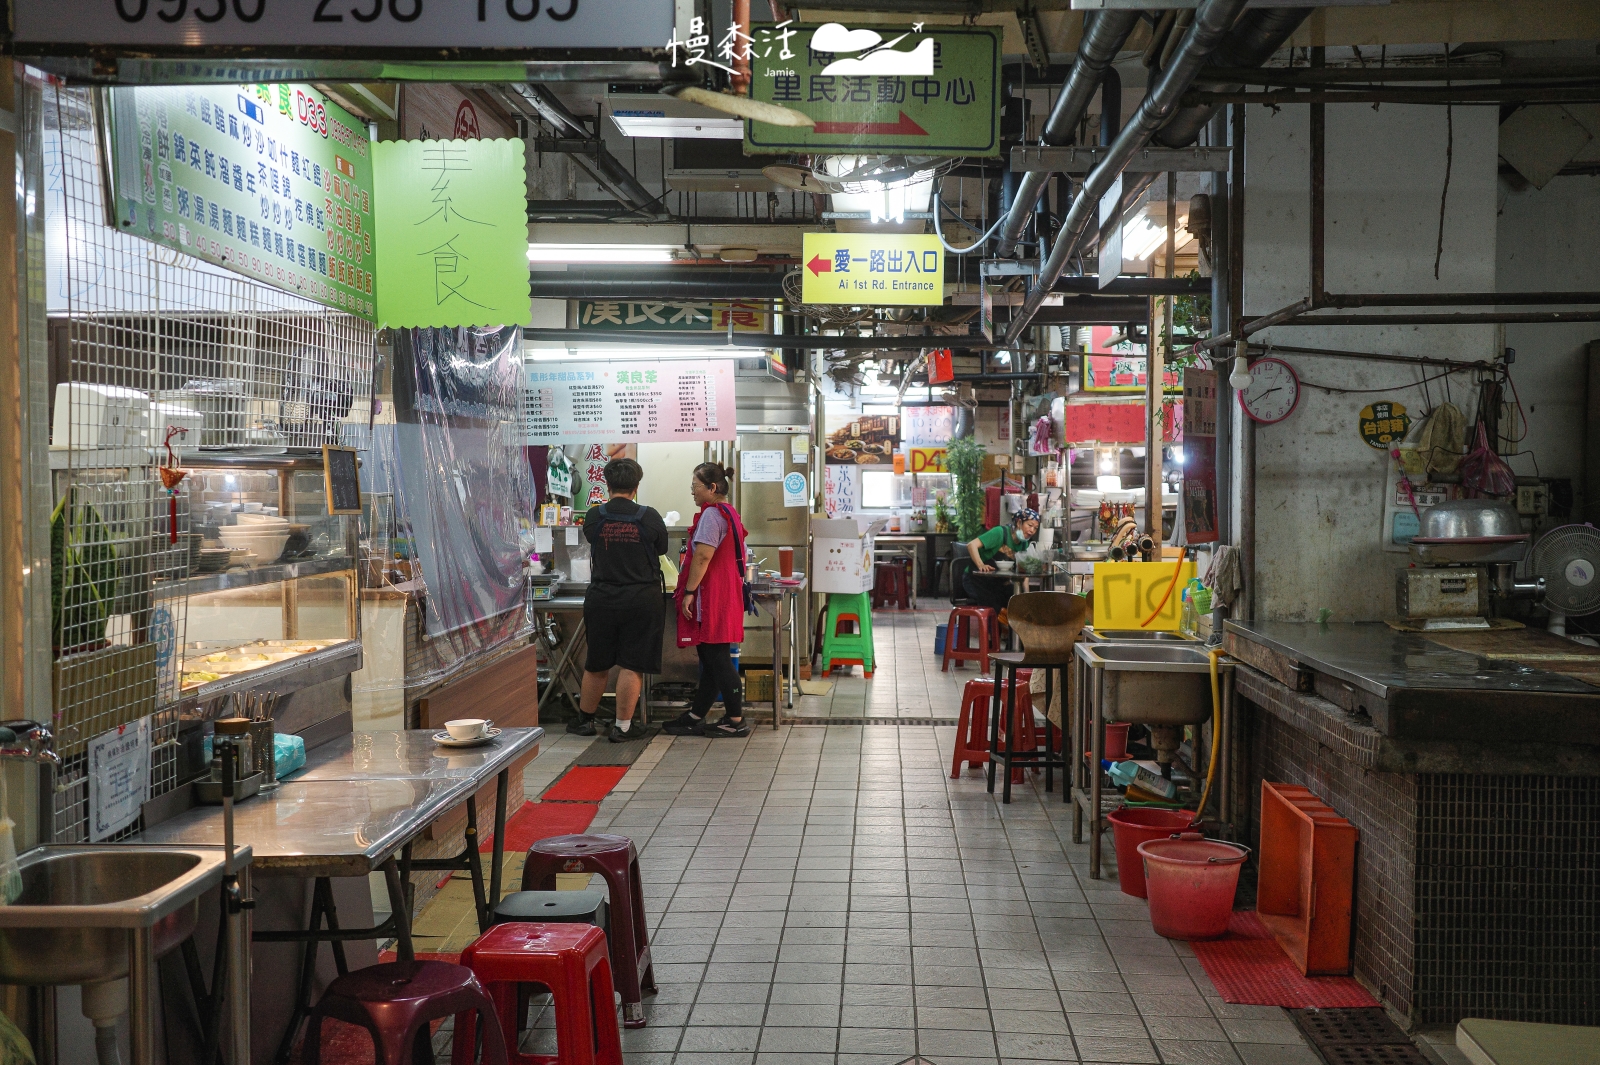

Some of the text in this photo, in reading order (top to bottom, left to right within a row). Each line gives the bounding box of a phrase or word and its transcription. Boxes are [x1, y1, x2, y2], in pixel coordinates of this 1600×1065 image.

[297, 90, 328, 138] D33
[772, 74, 976, 105] 里民活動中心
[163, 222, 175, 240] 30
[196, 234, 206, 252] 40
[228, 112, 247, 267] 麻醬麵 50
[242, 120, 261, 272] 炒年糕 90
[254, 127, 272, 253] 沙茶炒麵
[267, 135, 284, 258] 咖哩炒麵
[279, 141, 295, 263] 什錦炒麵
[290, 149, 305, 267] 麵疙瘩
[301, 156, 316, 272] 紅燒麵
[323, 166, 336, 281] 沙茶炒飯
[333, 173, 345, 285] 麻油炒飯
[342, 178, 354, 288] 咖哩炒飯
[352, 182, 363, 292] 什錦炒飯
[361, 189, 372, 296] 蛋包飯
[414, 142, 500, 310] 素食
[210, 240, 220, 257] 50
[835, 249, 937, 273] 愛一路出入口
[838, 279, 934, 290] Ai 1st Rd. Entrance
[616, 370, 657, 384] 漢良茶
[912, 418, 951, 427] 10:00
[1286, 375, 1291, 383] 2
[1364, 419, 1403, 435] 台灣豬
[912, 434, 950, 444] 16:00
